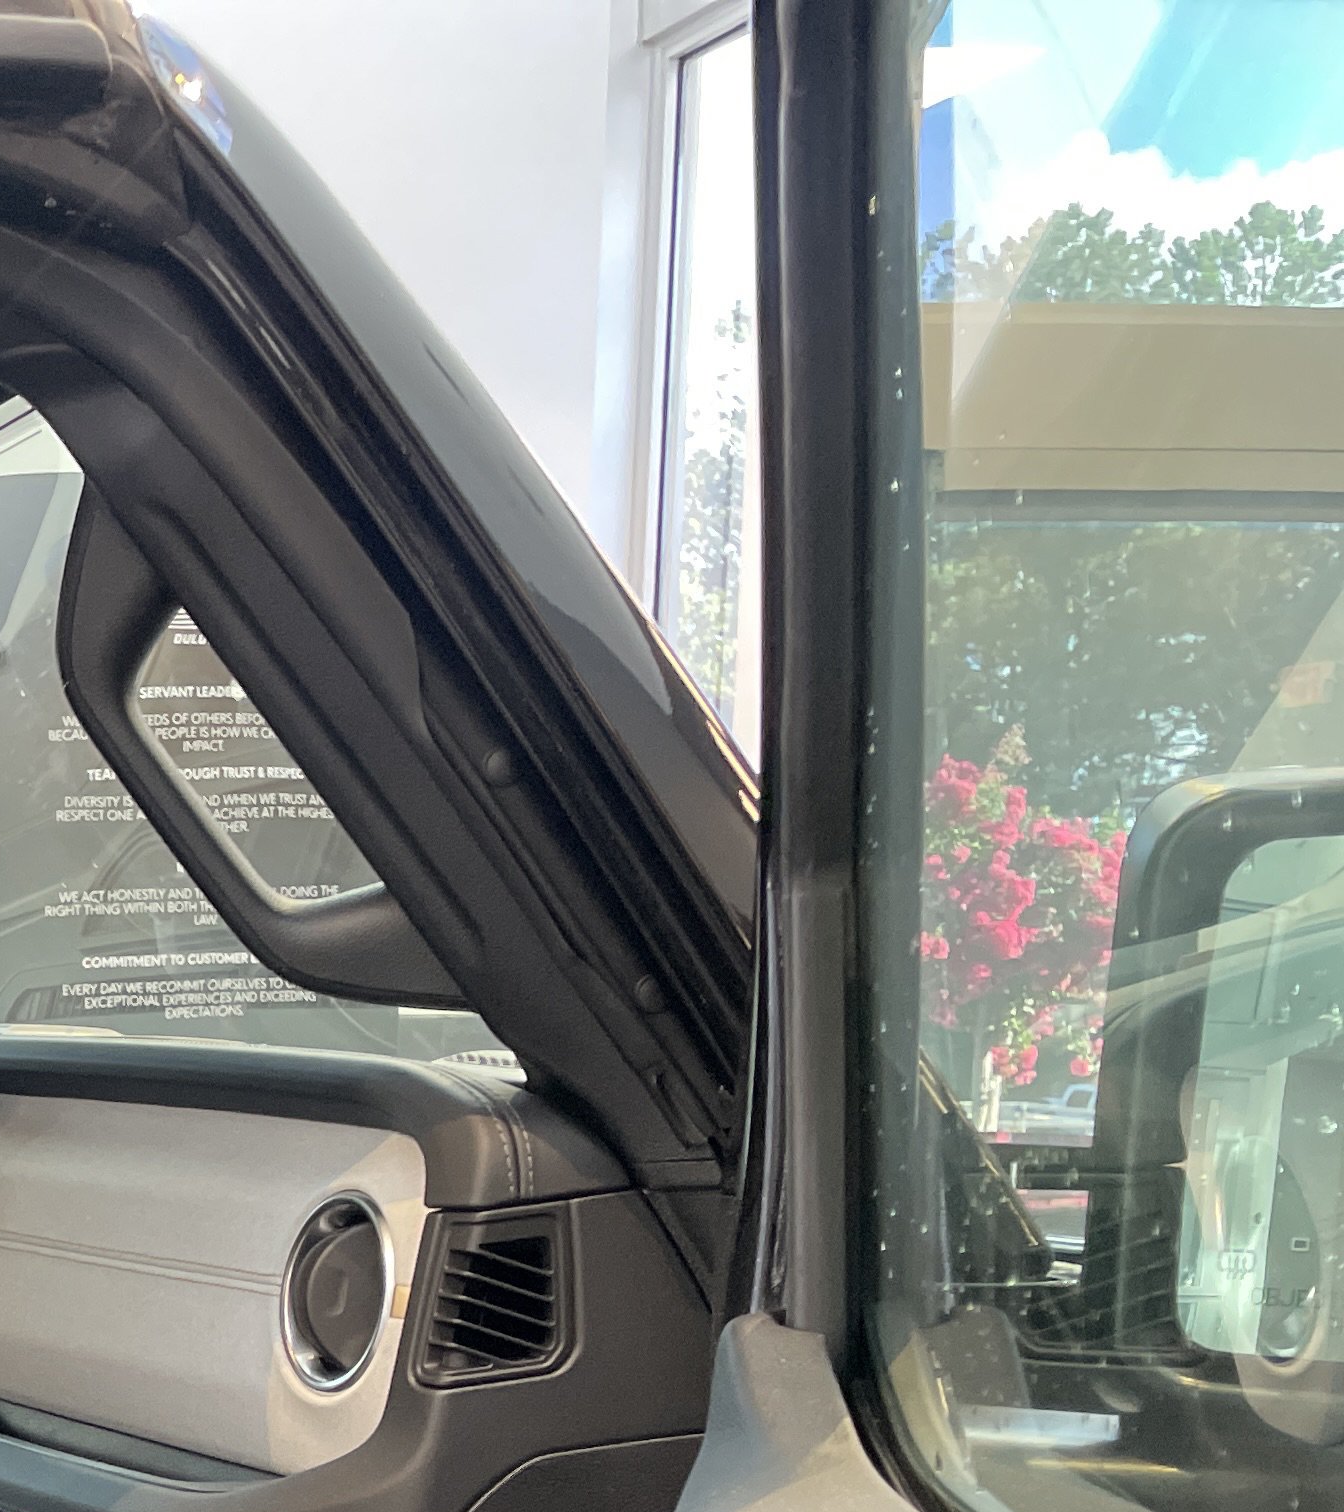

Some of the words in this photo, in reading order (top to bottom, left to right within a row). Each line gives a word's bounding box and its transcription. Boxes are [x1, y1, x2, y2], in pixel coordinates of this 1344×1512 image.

[173, 633, 207, 645] DULU
[139, 685, 194, 699] SERVANT
[172, 712, 188, 725] OF
[190, 712, 233, 725] OTHERS
[235, 711, 266, 725] BEFO
[48, 729, 88, 741] BECAU
[155, 727, 197, 740] PEOPLE
[199, 727, 209, 738] IS
[211, 726, 241, 739] HOW
[242, 727, 259, 738] WE
[222, 766, 255, 779] TRUST
[257, 766, 265, 778] &
[267, 766, 305, 779] RESPEC
[64, 796, 121, 808] DIVERSITY
[122, 796, 134, 807] IS
[203, 794, 221, 806] ND
[222, 793, 257, 805] WHEN
[258, 793, 277, 805] WE
[278, 792, 307, 805] TRUST
[55, 809, 105, 822] RESPECT
[106, 808, 134, 821] ONE
[213, 807, 260, 820] ACHIEVE
[261, 806, 275, 818] AT
[276, 806, 297, 818] THE
[297, 807, 335, 819] HIGHES
[58, 891, 79, 903] WE
[80, 890, 105, 902] ACT
[107, 888, 166, 902] HONESTLY
[167, 887, 192, 900] AND
[280, 885, 319, 898] DOING
[44, 904, 82, 917] RIGHT
[83, 903, 121, 916] THING
[122, 901, 165, 915] WITHIN
[166, 900, 198, 914] BOTH
[81, 954, 168, 969] COMMITMENT
[170, 953, 186, 966] TO
[187, 952, 249, 966] CUSTOMER
[62, 983, 98, 996] EVERY
[99, 982, 124, 995] DAY
[124, 981, 144, 993] WE
[145, 979, 206, 994] RECOMMIT
[207, 977, 268, 991] OURSELVES
[268, 977, 284, 990] TO
[84, 994, 160, 1010] EXCEPTIONAL
[162, 991, 232, 1006] EXPERIENCES
[233, 990, 258, 1003] AND
[259, 989, 317, 1003] EXCEEDING
